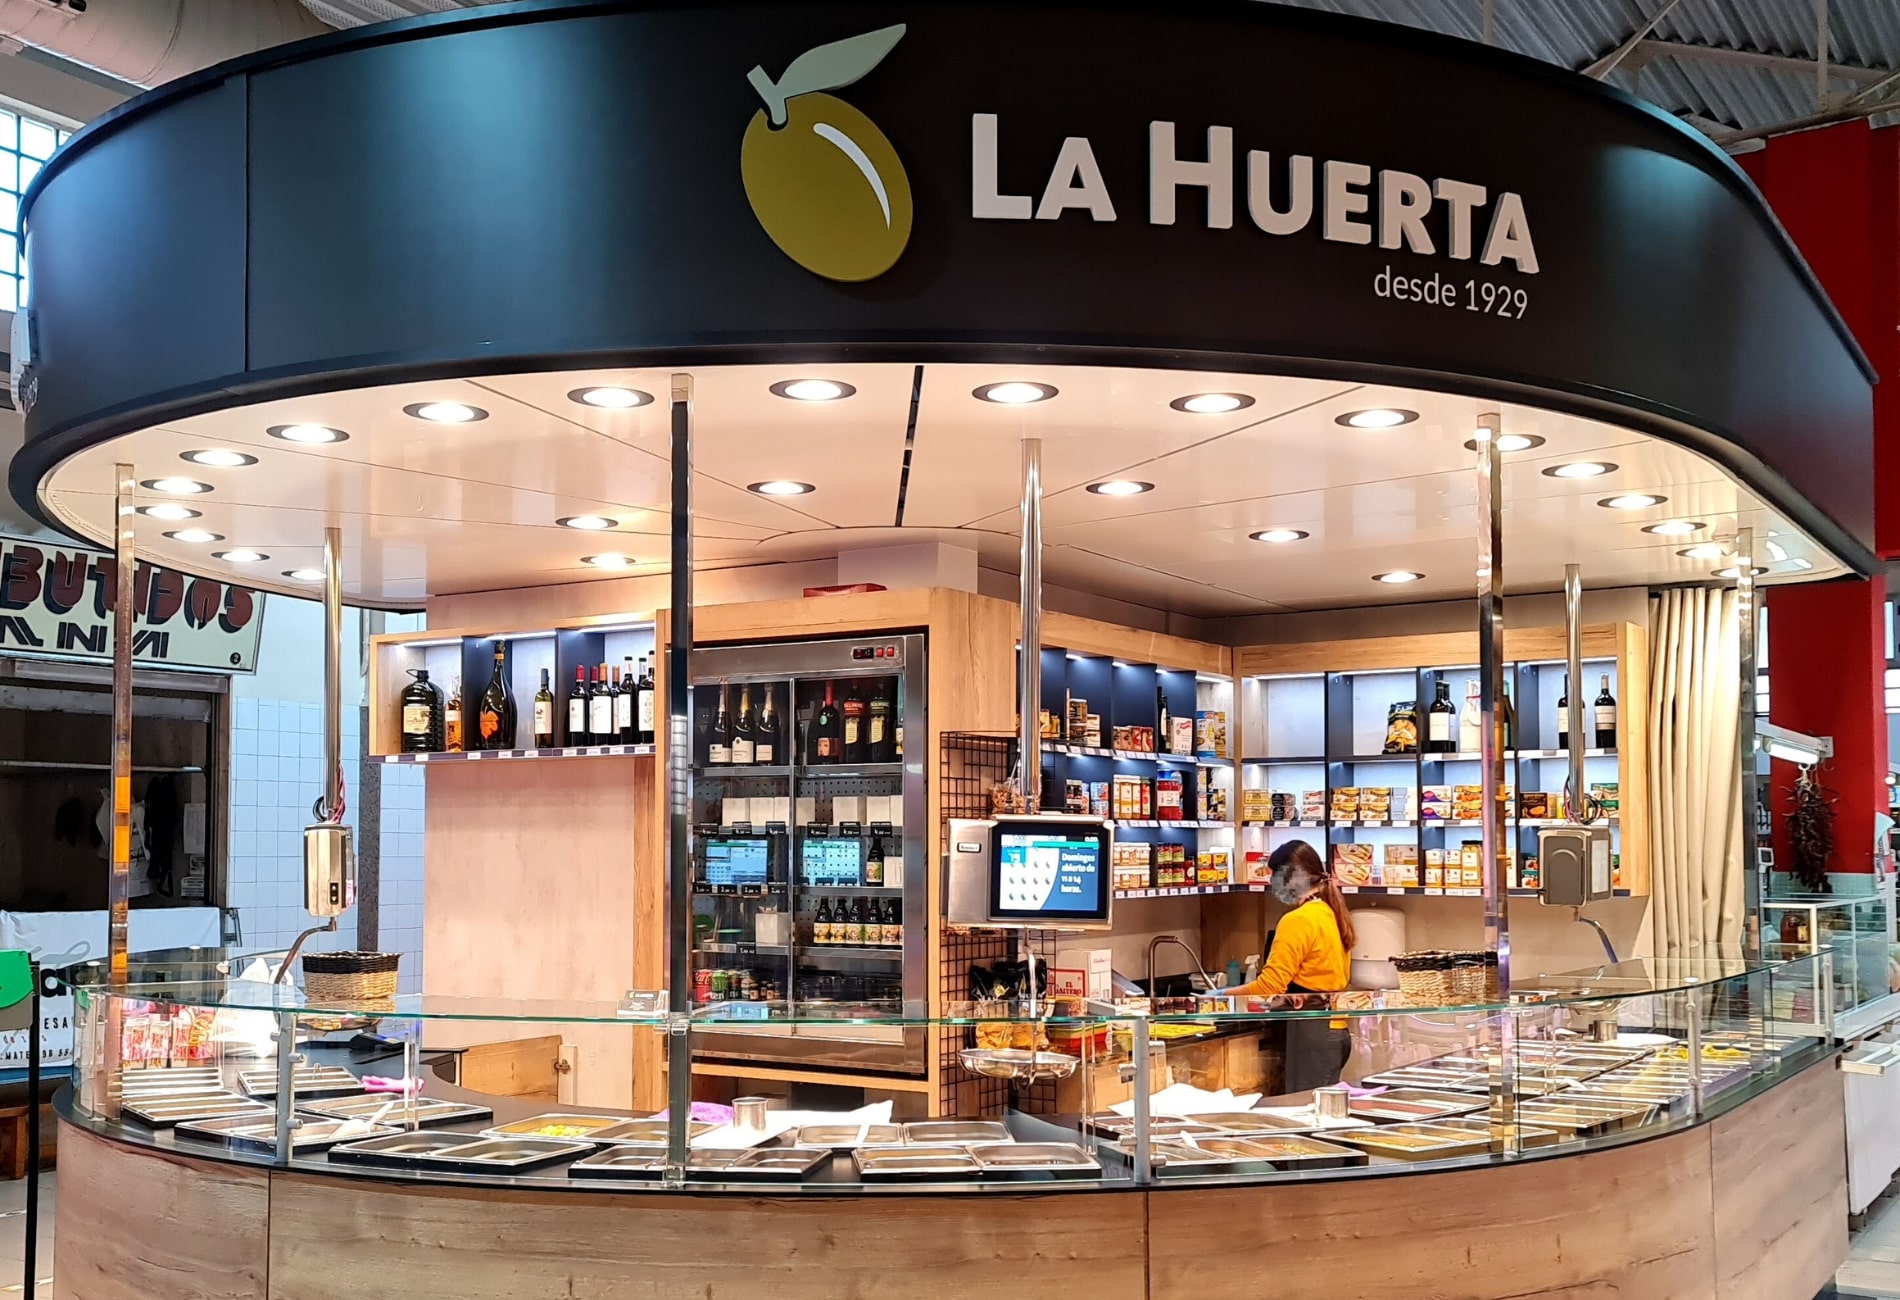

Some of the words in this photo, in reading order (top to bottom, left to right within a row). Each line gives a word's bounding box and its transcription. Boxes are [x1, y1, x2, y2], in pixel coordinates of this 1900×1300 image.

[972, 113, 1117, 221] LA
[1150, 120, 1539, 274] HUERTA
[1373, 265, 1457, 308] desde
[1465, 280, 1528, 319] 1929
[1061, 853, 1095, 863] Domingos
